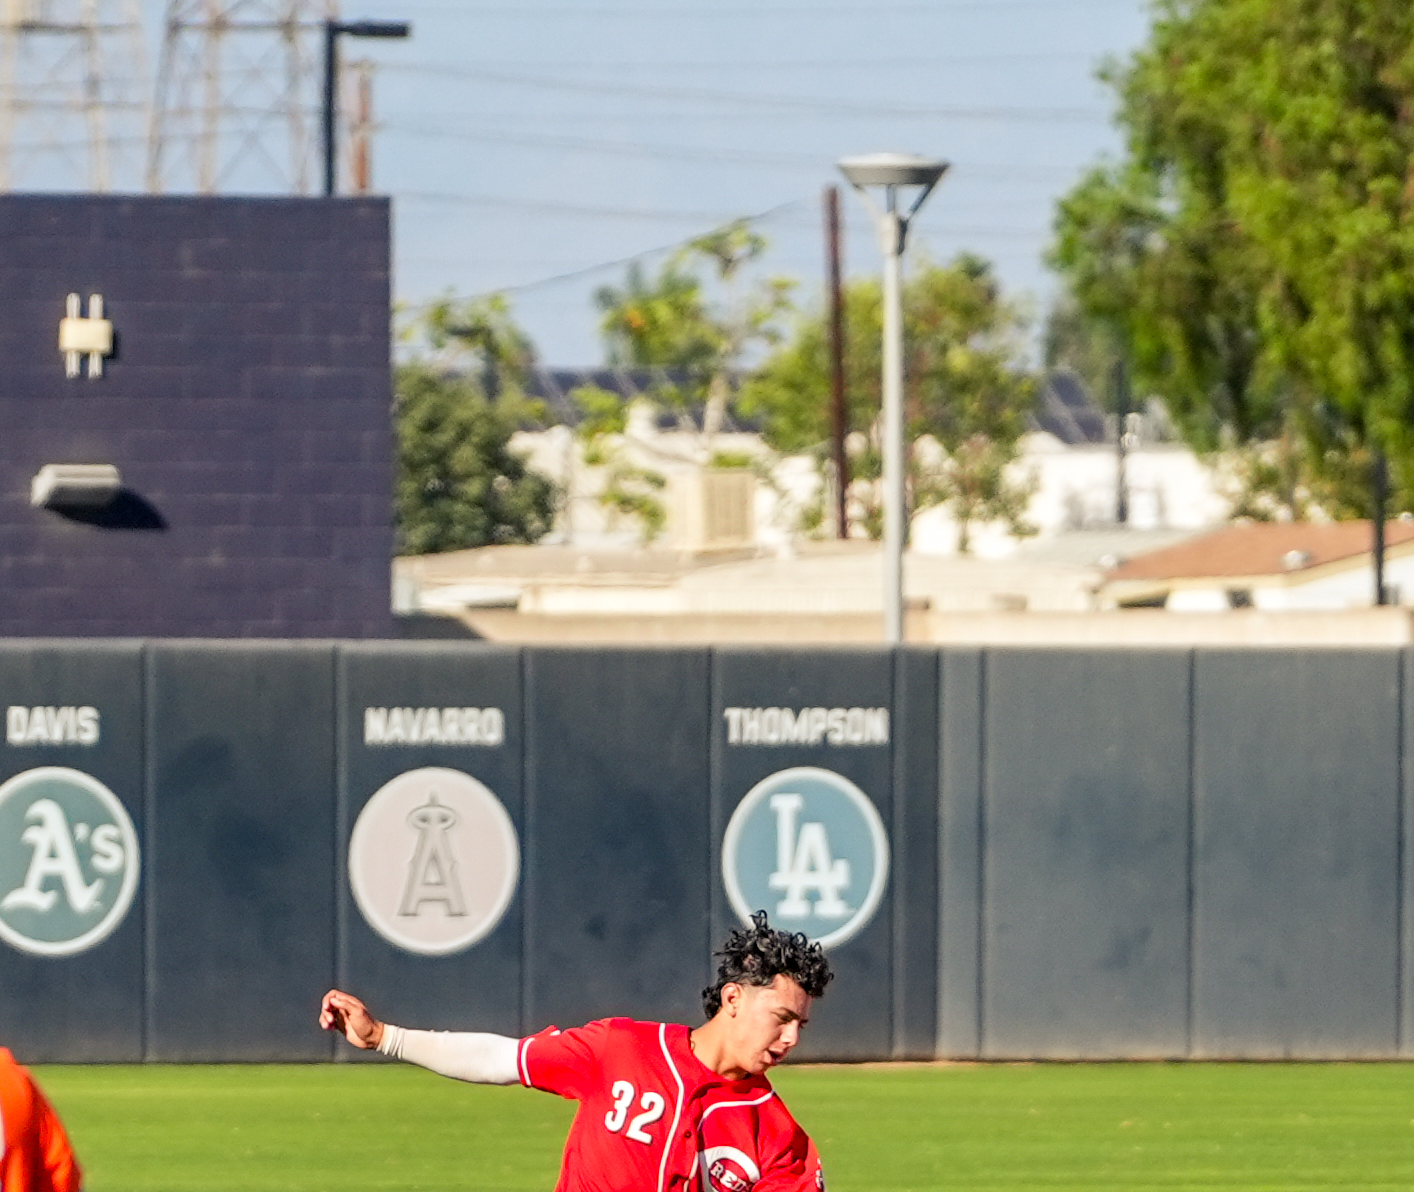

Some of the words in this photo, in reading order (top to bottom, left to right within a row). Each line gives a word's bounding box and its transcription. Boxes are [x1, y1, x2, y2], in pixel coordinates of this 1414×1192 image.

[6, 705, 100, 746] DAVIS
[364, 706, 504, 746] NAVARRO
[723, 706, 889, 746] THOMPSON
[768, 793, 851, 918] LA
[604, 1080, 666, 1145] 32
